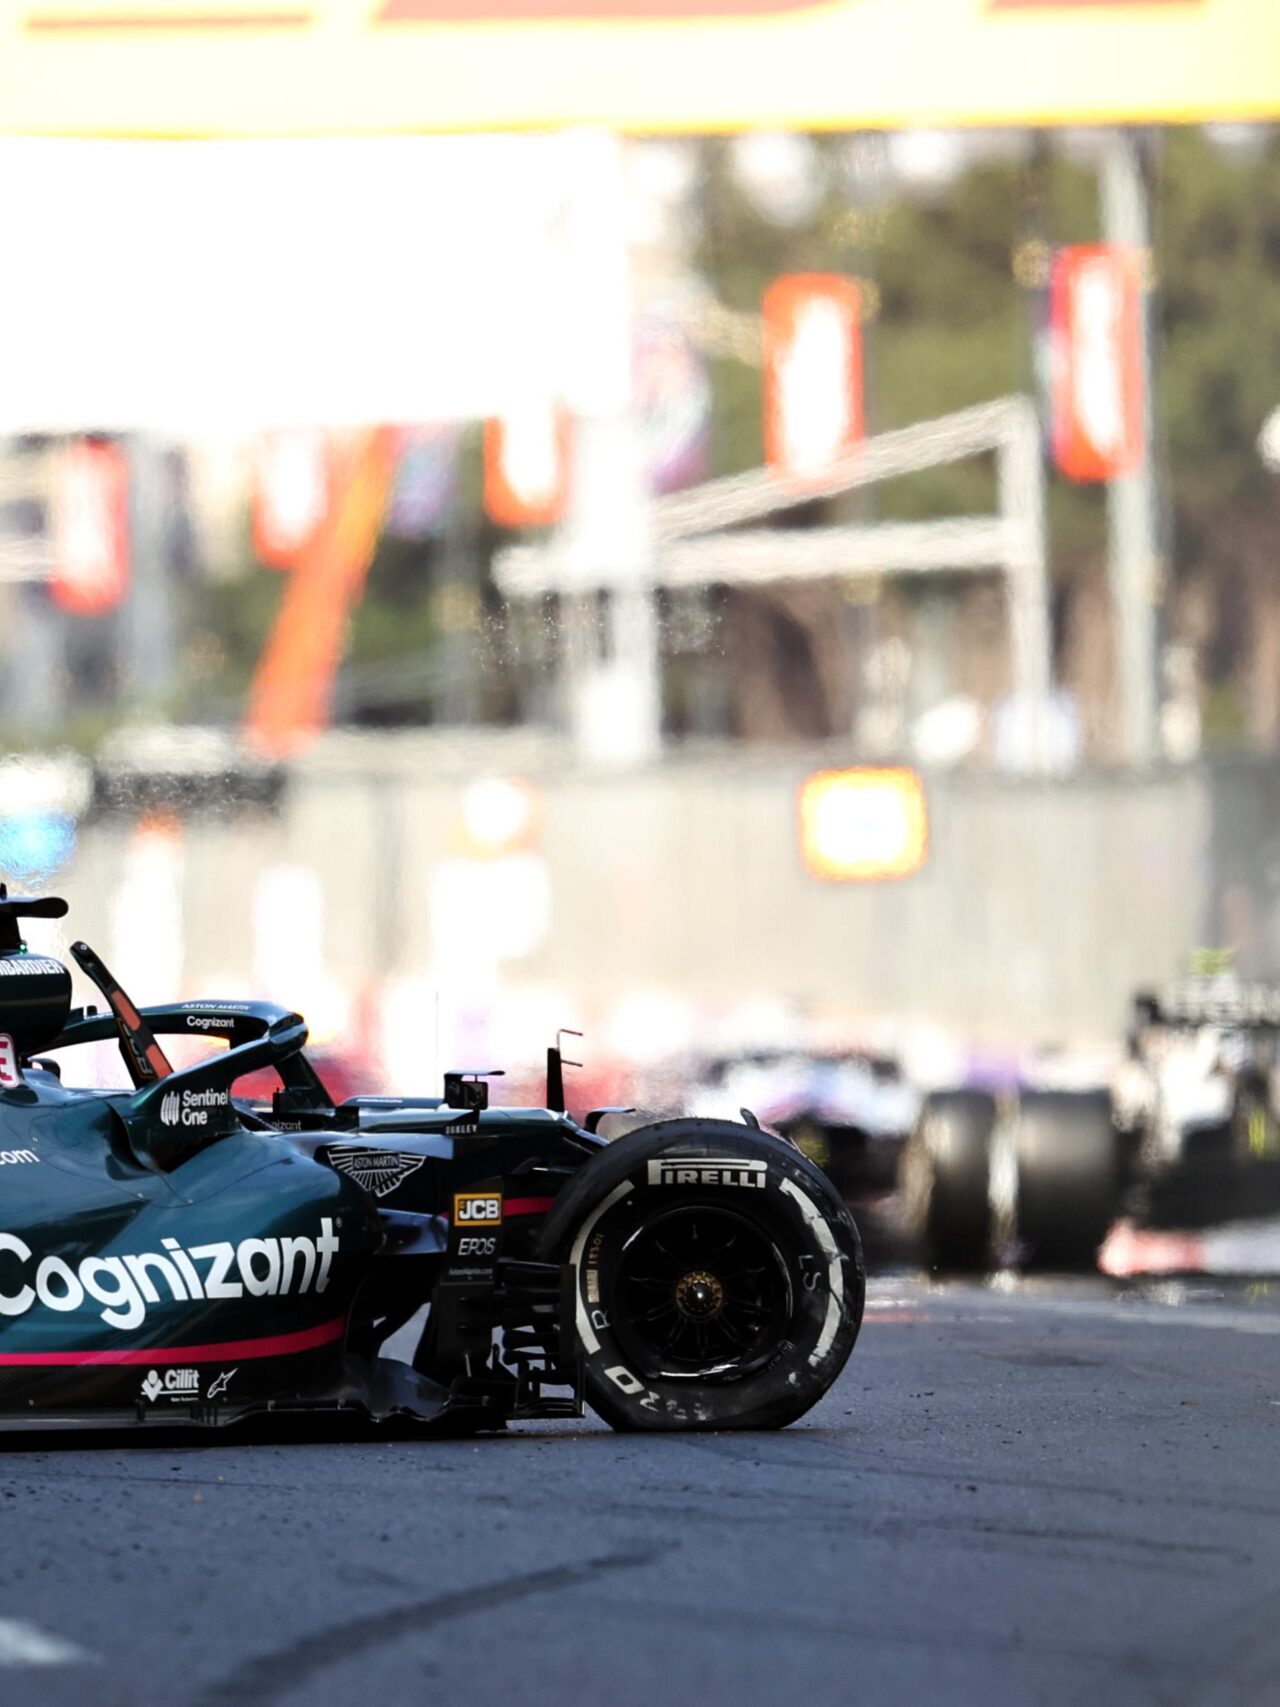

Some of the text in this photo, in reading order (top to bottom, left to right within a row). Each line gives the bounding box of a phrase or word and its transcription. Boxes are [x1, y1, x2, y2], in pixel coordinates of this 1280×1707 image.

[186, 1015, 235, 1029] Cognizant
[181, 1088, 229, 1107] Sentinel
[181, 1109, 208, 1126] One
[647, 1158, 768, 1188] PIRELLI
[459, 1199, 499, 1219] JCB
[458, 1238, 496, 1255] EPOS
[165, 1369, 200, 1389] Cillit
